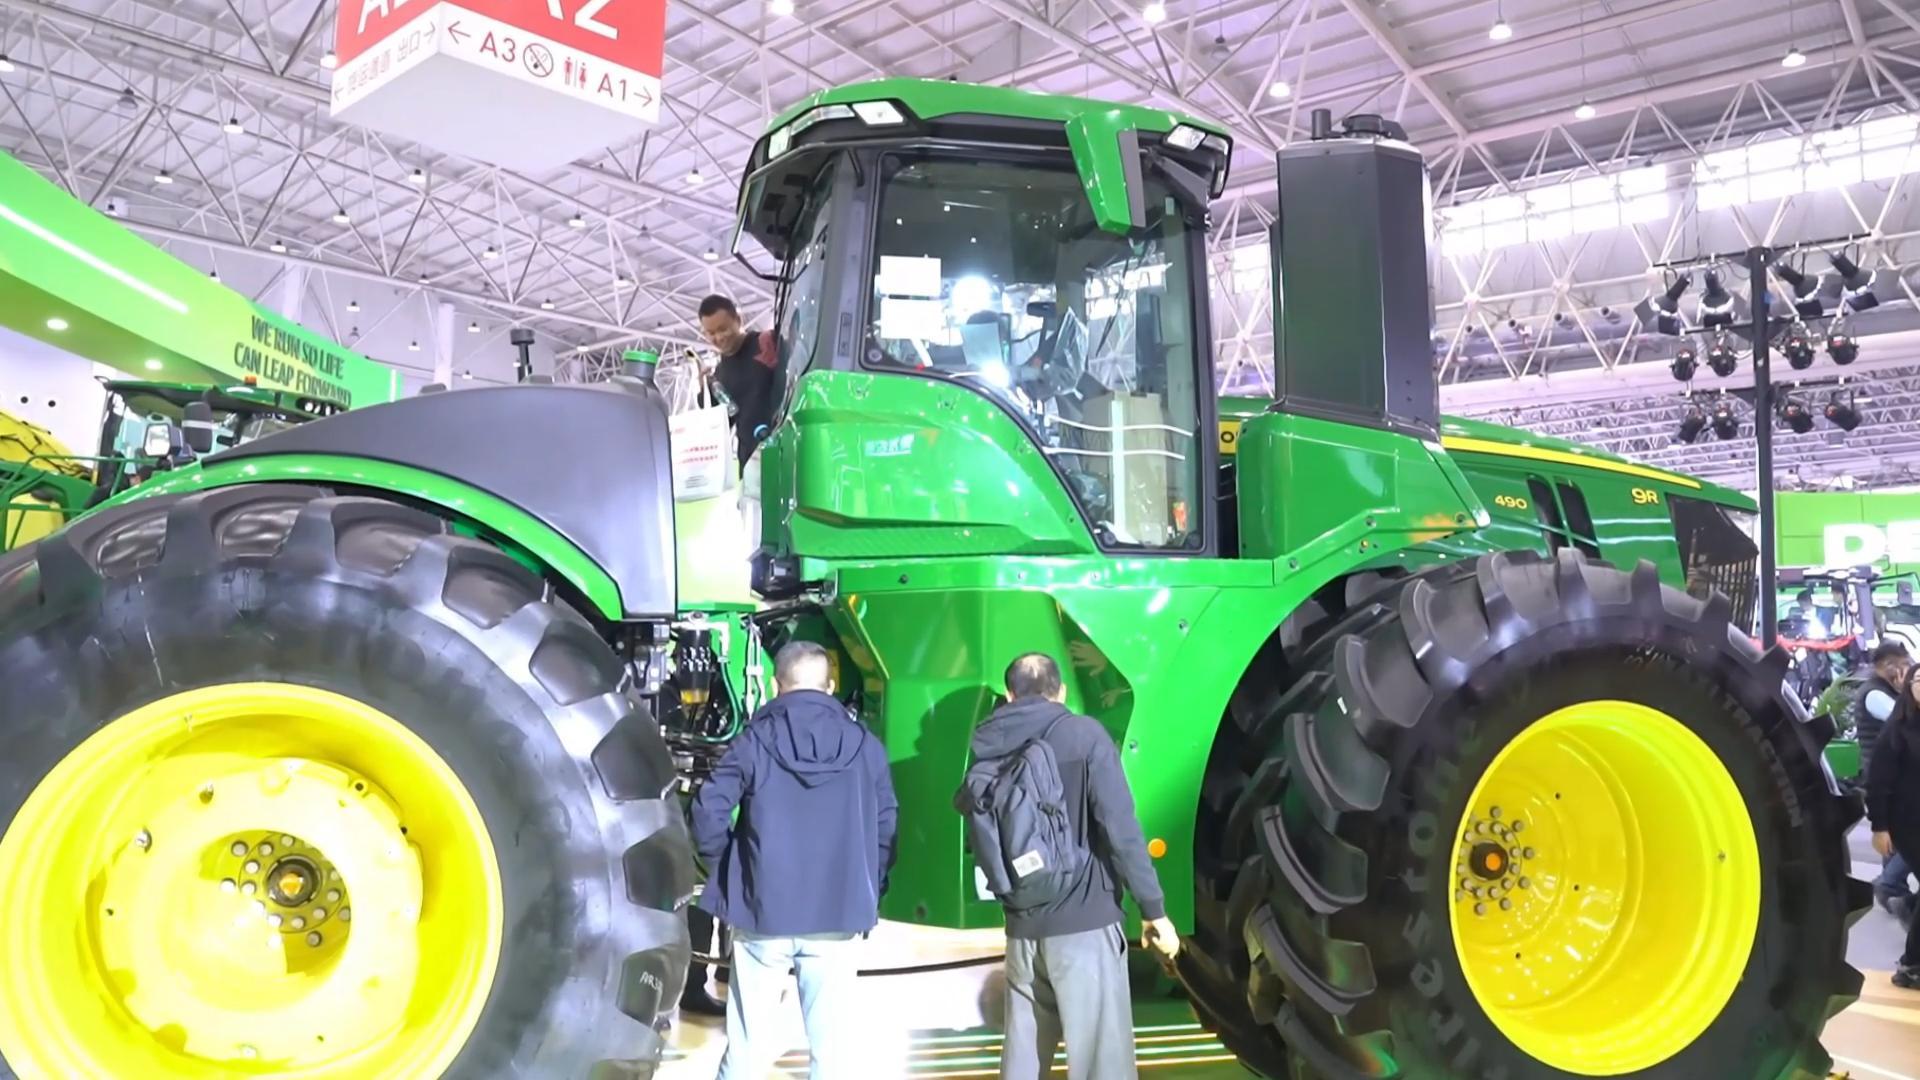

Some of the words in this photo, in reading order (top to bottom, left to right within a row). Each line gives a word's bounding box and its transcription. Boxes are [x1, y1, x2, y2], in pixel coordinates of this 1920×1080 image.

[479, 31, 516, 63] A3
[597, 73, 627, 102] A1
[234, 342, 262, 375] CAN
[264, 355, 294, 387] LEAP
[251, 315, 272, 348] WE
[274, 327, 300, 361] RUN
[320, 349, 345, 380] LIFE
[1494, 494, 1528, 510] 490
[1631, 487, 1659, 505] 9R
